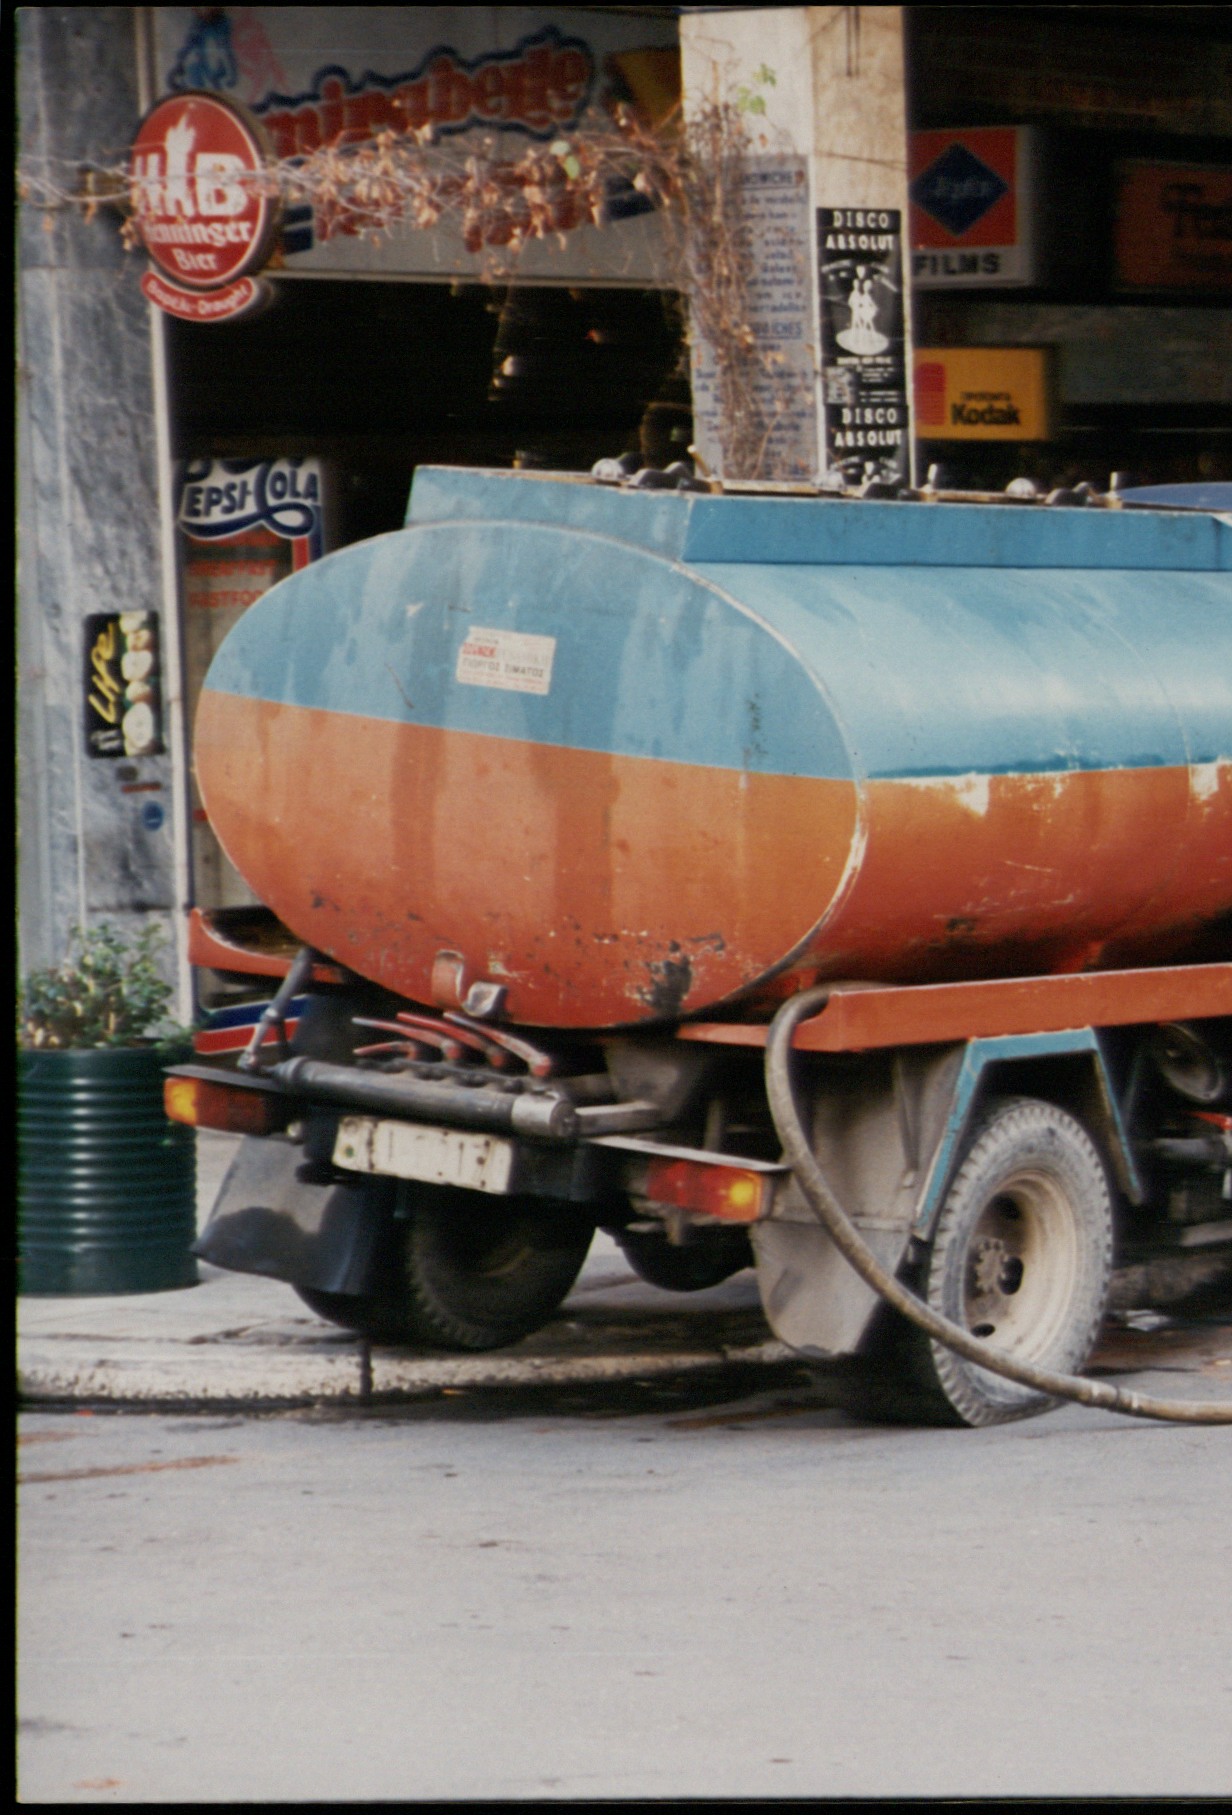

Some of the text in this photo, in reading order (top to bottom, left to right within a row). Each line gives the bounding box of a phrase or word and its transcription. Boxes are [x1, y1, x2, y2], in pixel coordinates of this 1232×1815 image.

[833, 210, 889, 229] DISCO
[826, 233, 894, 251] ABSOLUT
[911, 253, 1001, 276] FILMS
[841, 407, 898, 425] DISCO
[951, 402, 1021, 426] Kodak
[834, 429, 902, 448] ABSOLUT
